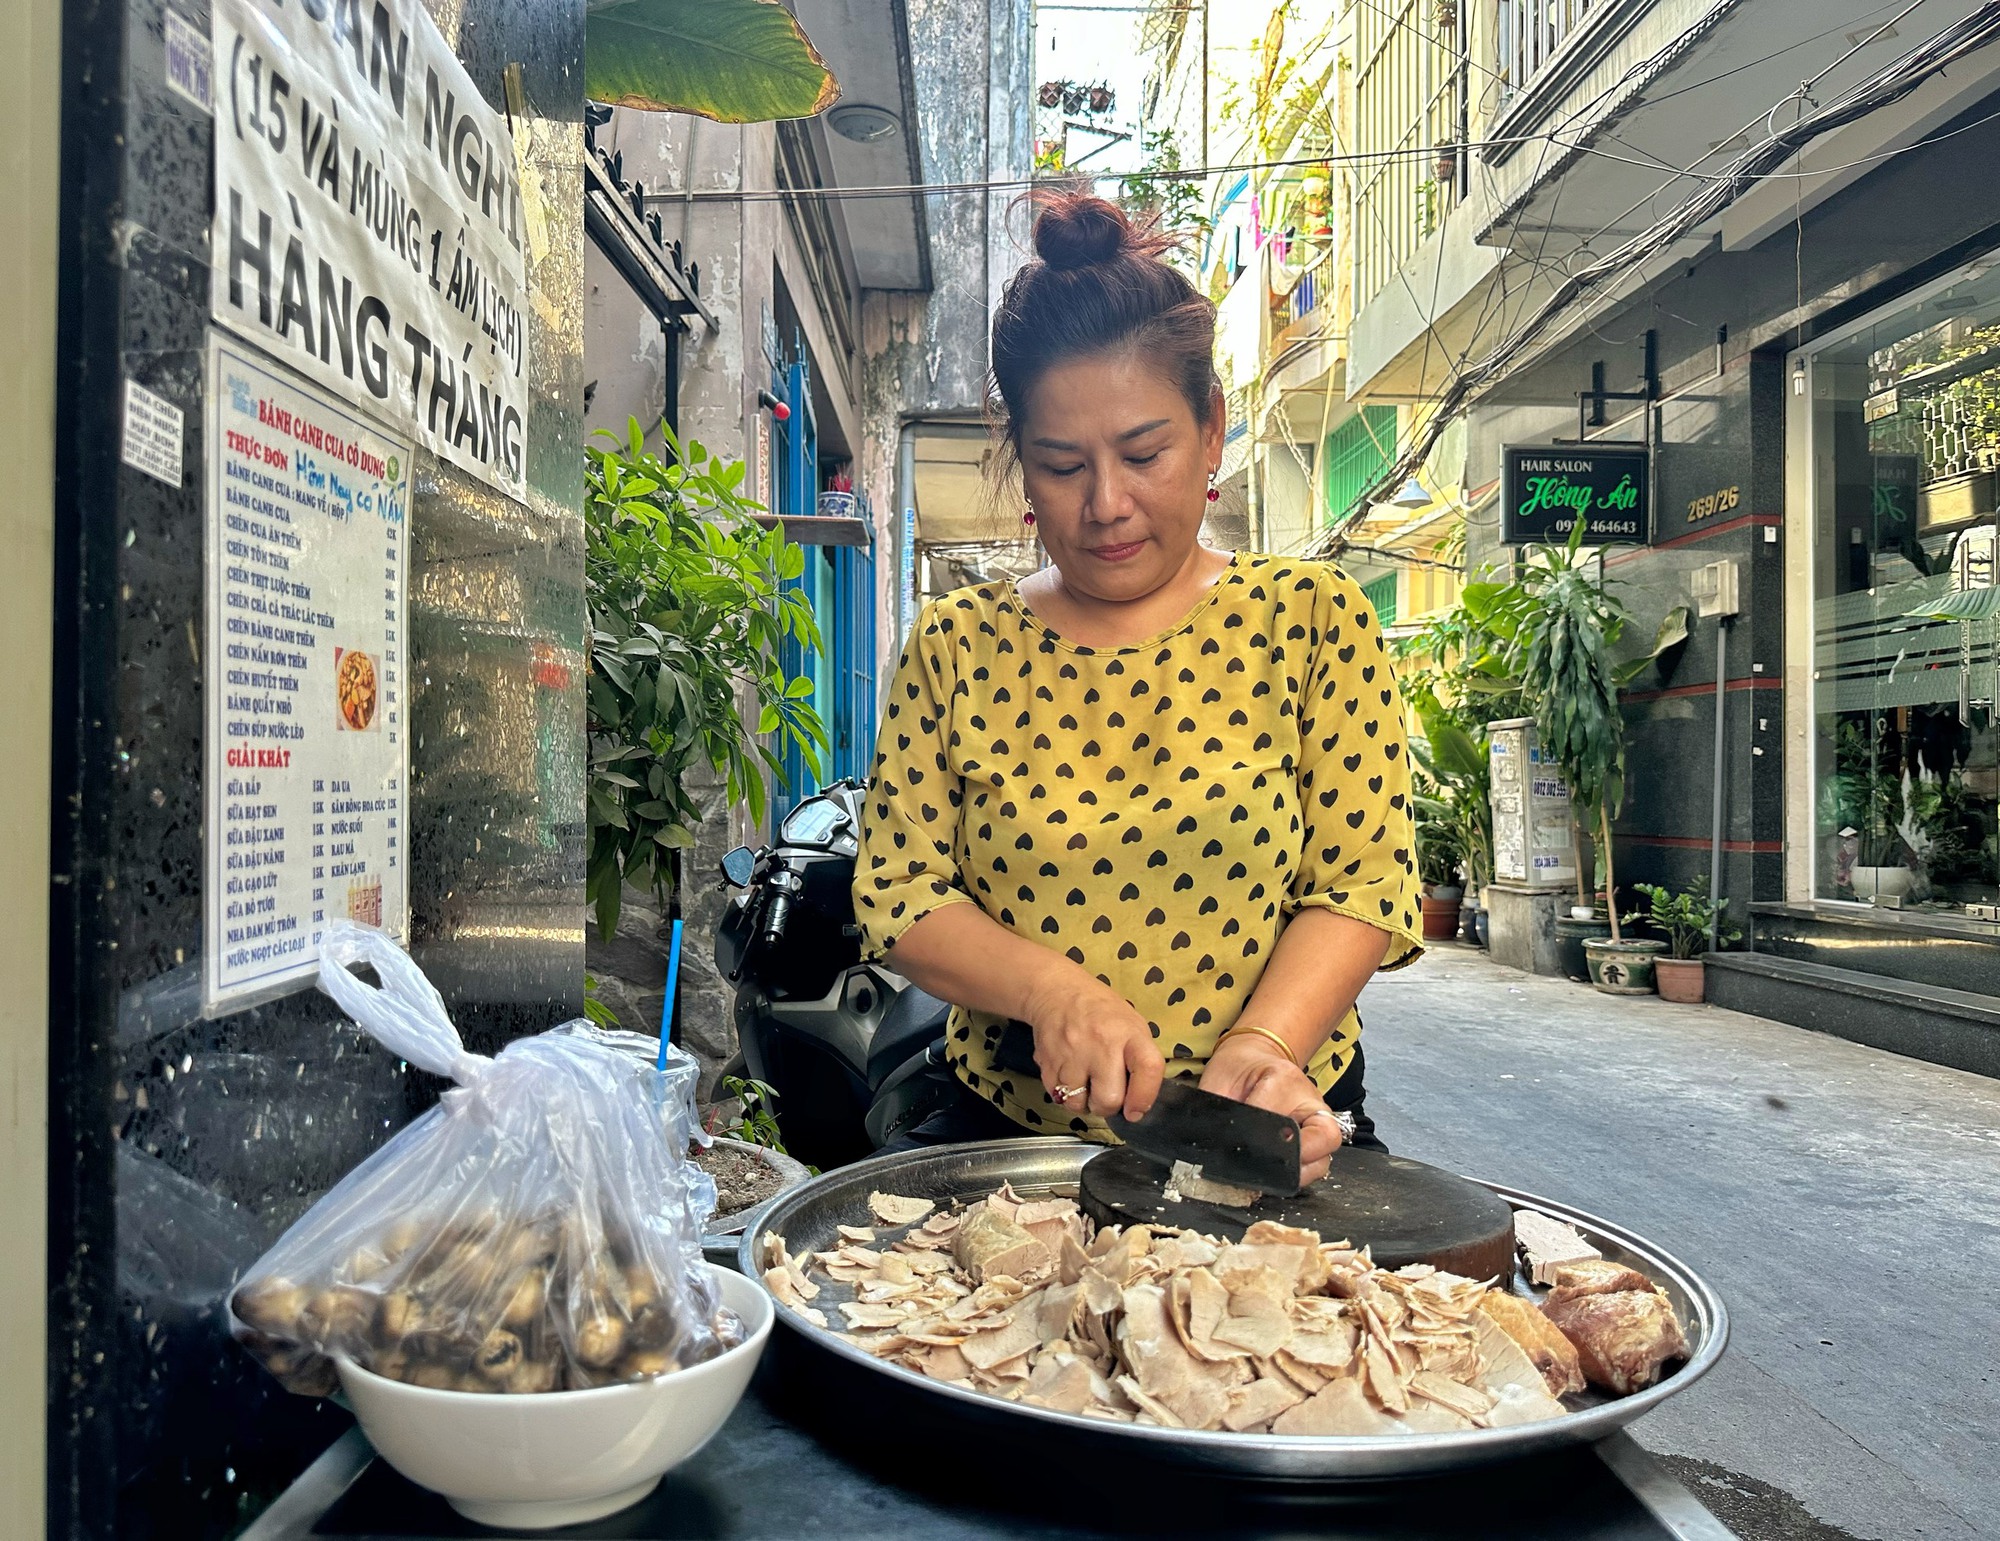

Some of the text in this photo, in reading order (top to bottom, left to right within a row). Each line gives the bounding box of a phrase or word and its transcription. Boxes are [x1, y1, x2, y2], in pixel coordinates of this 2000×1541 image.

[230, 33, 290, 154] (15
[302, 96, 339, 204] VÀ
[350, 147, 421, 273] MÙNG
[429, 229, 442, 293] 1
[481, 275, 522, 378] LỊCH)
[229, 186, 522, 485] HÀNG THÁNG
[259, 398, 385, 480] BÁNH CANH CUA CÔ DUNG
[227, 429, 289, 472] THỰC ĐƠN
[1520, 459, 1592, 473] HAIR SALON
[227, 460, 250, 484] BÁNH
[252, 469, 274, 492] CANH
[275, 478, 291, 497] CUA
[295, 489, 316, 510] MANG
[317, 494, 327, 514] VỀ
[1519, 473, 1638, 516] Hồng Ân
[227, 487, 291, 523] BÁNH CANH CUA
[1687, 486, 1740, 523] 269/26
[227, 514, 249, 533] CHÉN
[251, 523, 267, 540] CUA
[1590, 520, 1637, 533] 464643
[227, 539, 249, 558] CHÉN
[227, 564, 249, 583] CHÉN
[227, 591, 249, 609] CHÉN
[281, 604, 301, 621] THÁC
[227, 617, 316, 648] CHÉN BÁNH CANH THÊM
[385, 628, 396, 642] 15K
[228, 642, 250, 660] CHÉN
[385, 649, 396, 662] 15K
[228, 667, 250, 685] CHÉN
[251, 669, 277, 689] HUYẾT
[385, 670, 396, 683] 15K
[228, 693, 251, 711] BÁNH
[228, 719, 250, 737] CHÉN
[252, 720, 267, 738] SÚP
[227, 741, 290, 768] GIẢI KHÁT
[228, 778, 243, 796] SỮA
[313, 780, 324, 792] 15K
[331, 781, 350, 793] DA UA
[228, 803, 277, 821] SỮA HẠT SEN
[313, 802, 324, 814] 15K
[362, 800, 374, 812] HOA
[228, 826, 285, 845] SỮA ĐẬU XANH
[313, 823, 324, 836] 15K
[313, 845, 324, 858] 15K
[331, 843, 345, 856] RAU
[228, 852, 243, 869] SỮA
[245, 850, 262, 869] ĐẬU
[313, 867, 324, 879] 15K
[228, 876, 243, 894] SỮA
[245, 876, 261, 893] GẠO
[313, 888, 324, 901] 15K
[228, 901, 243, 918] SỮA
[313, 909, 324, 923] 15K
[228, 927, 244, 943] NHA
[246, 921, 263, 939] ĐAM
[228, 948, 250, 968] NƯỚC
[251, 944, 272, 962] NGỌT
[273, 939, 288, 955] CÁC
